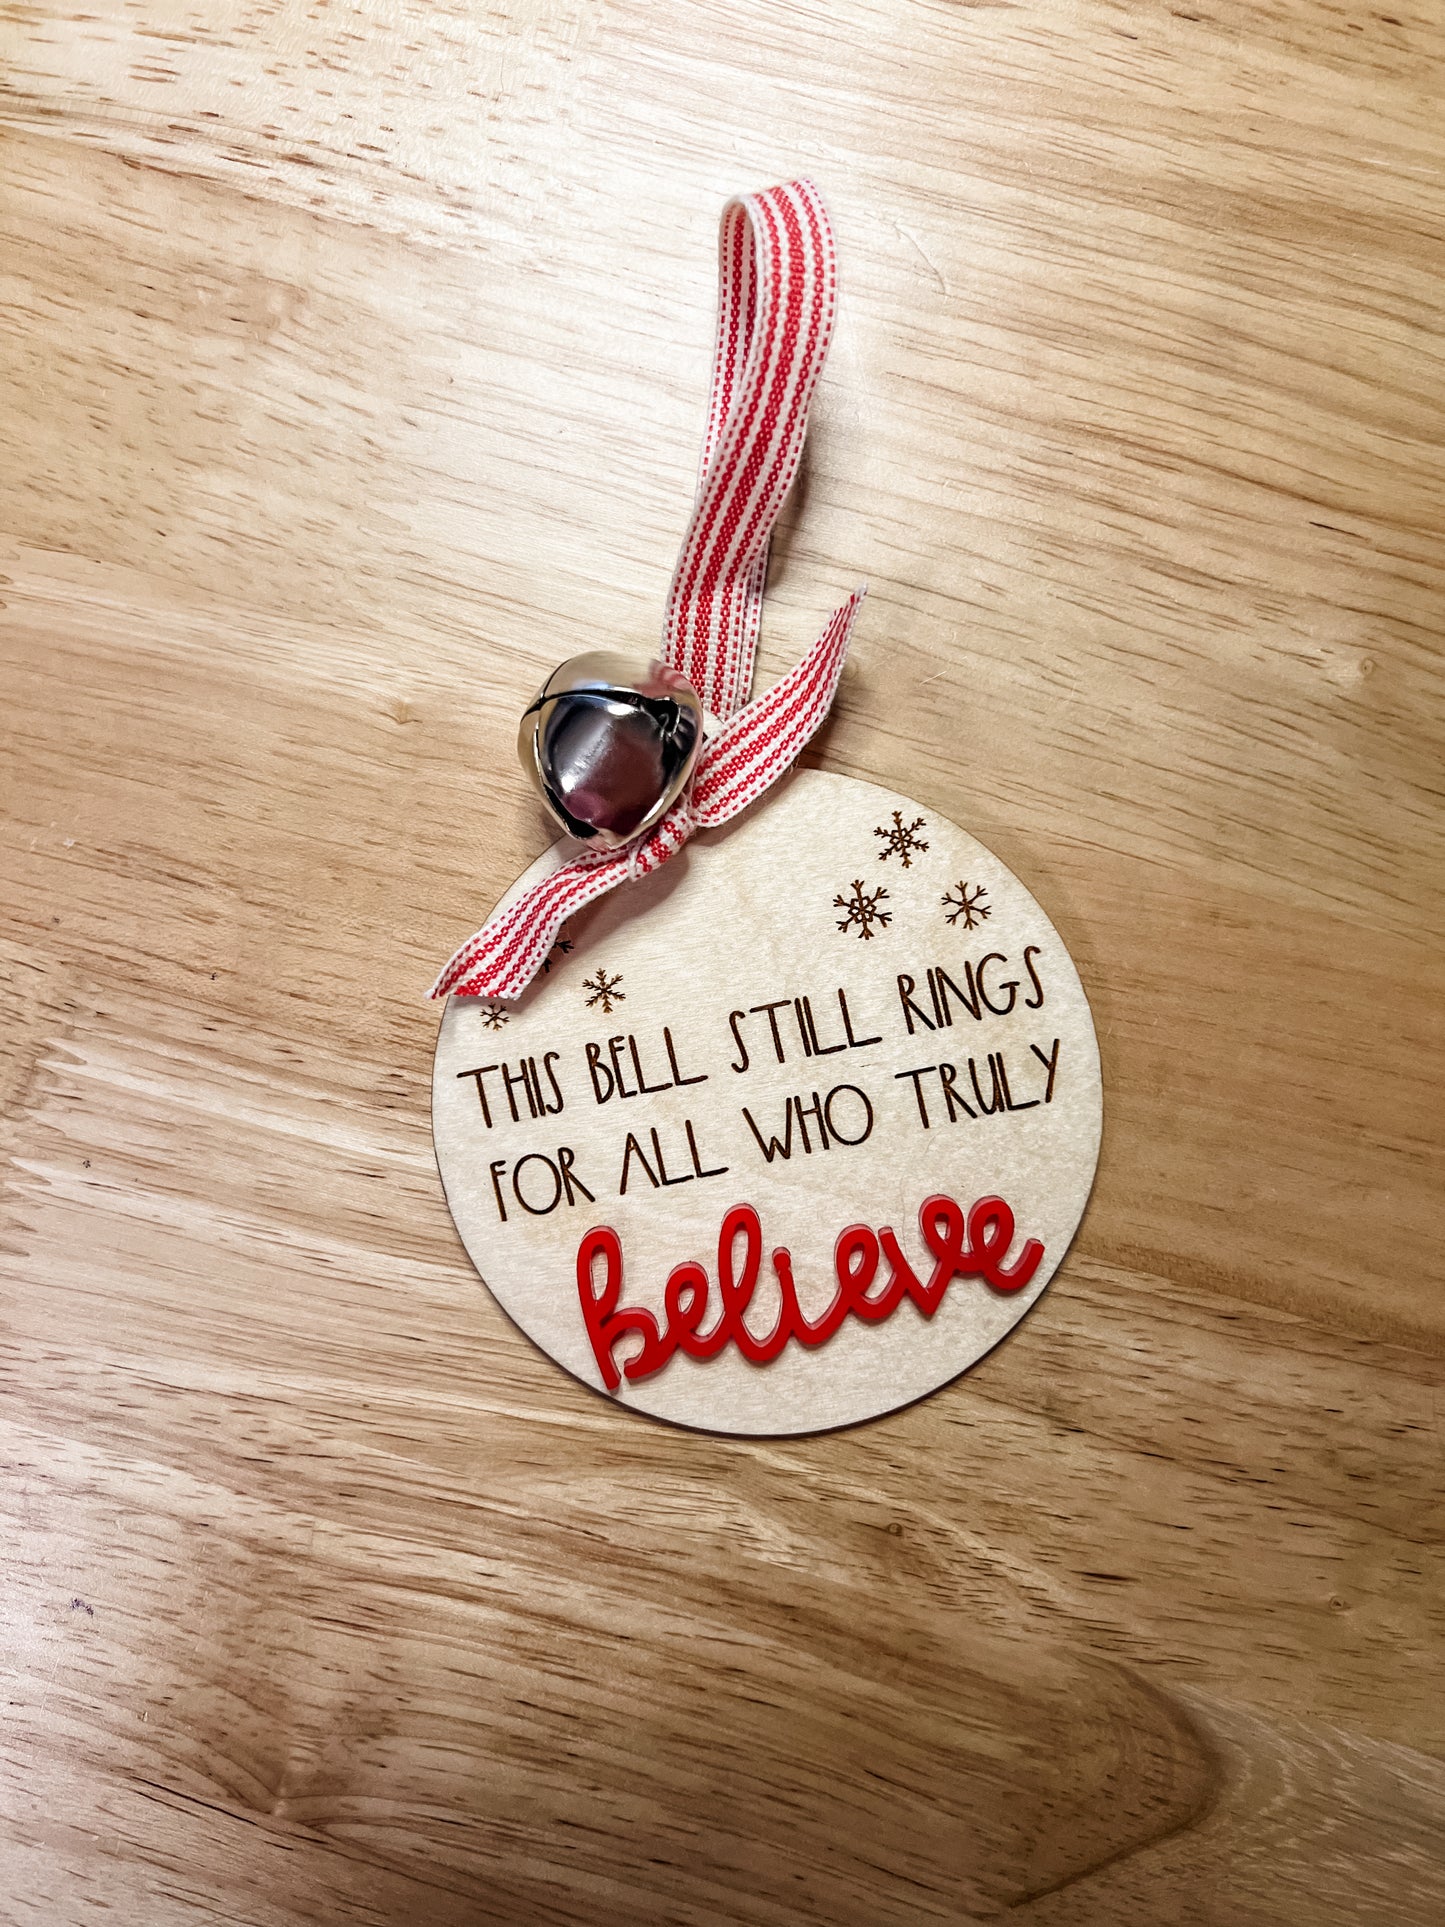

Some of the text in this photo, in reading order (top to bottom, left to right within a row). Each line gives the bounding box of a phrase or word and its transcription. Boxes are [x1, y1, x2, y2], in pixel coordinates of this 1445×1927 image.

[457, 945, 1044, 1128] THIS BELL STILL RINGS
[490, 1038, 1060, 1222] FOR ALL WHO TRULY
[576, 1194, 1045, 1390] believe
